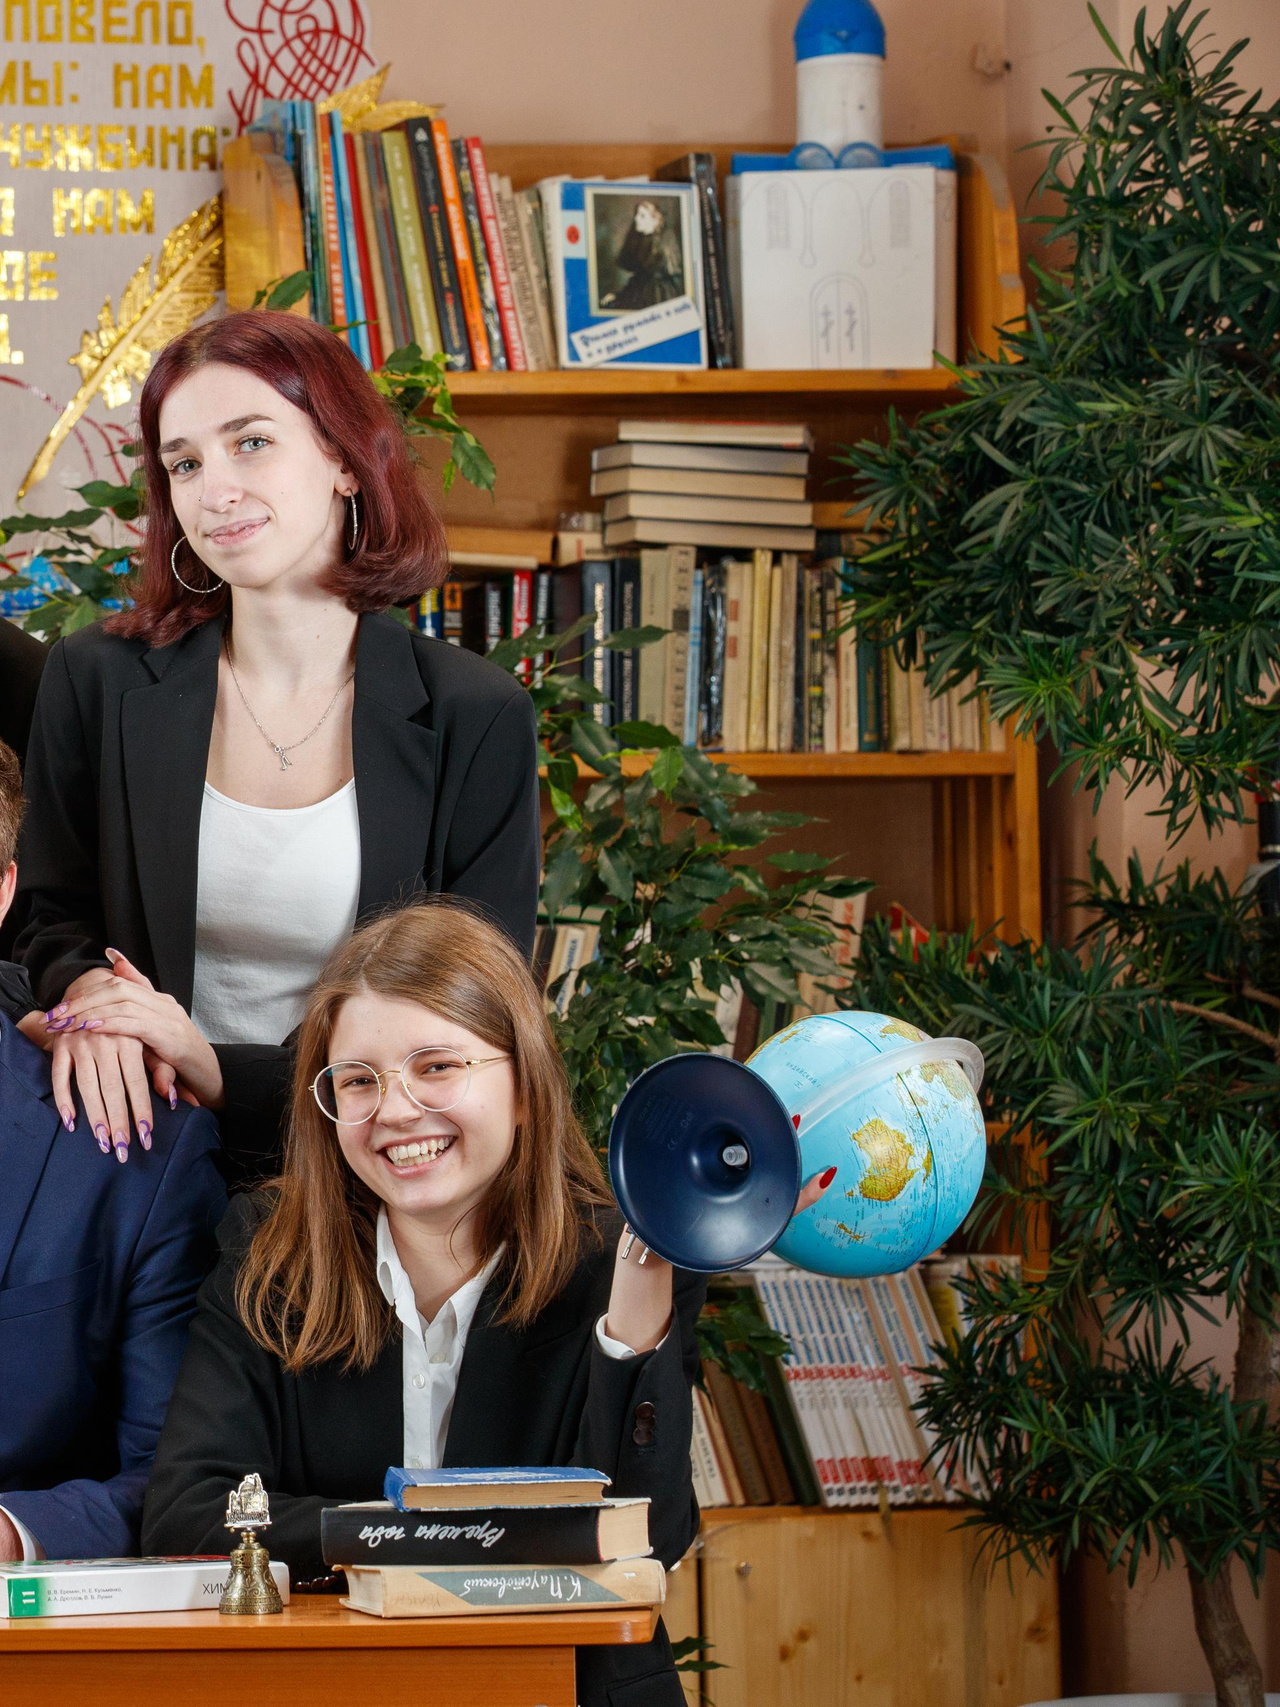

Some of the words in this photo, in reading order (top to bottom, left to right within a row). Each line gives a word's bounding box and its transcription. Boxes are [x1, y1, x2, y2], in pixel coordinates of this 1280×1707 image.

[3, 0, 206, 58] ПОВЕЛО,
[113, 62, 214, 109] НАМ
[53, 187, 155, 238] НАМ
[358, 1524, 406, 1548] года
[414, 1519, 506, 1548] Времена
